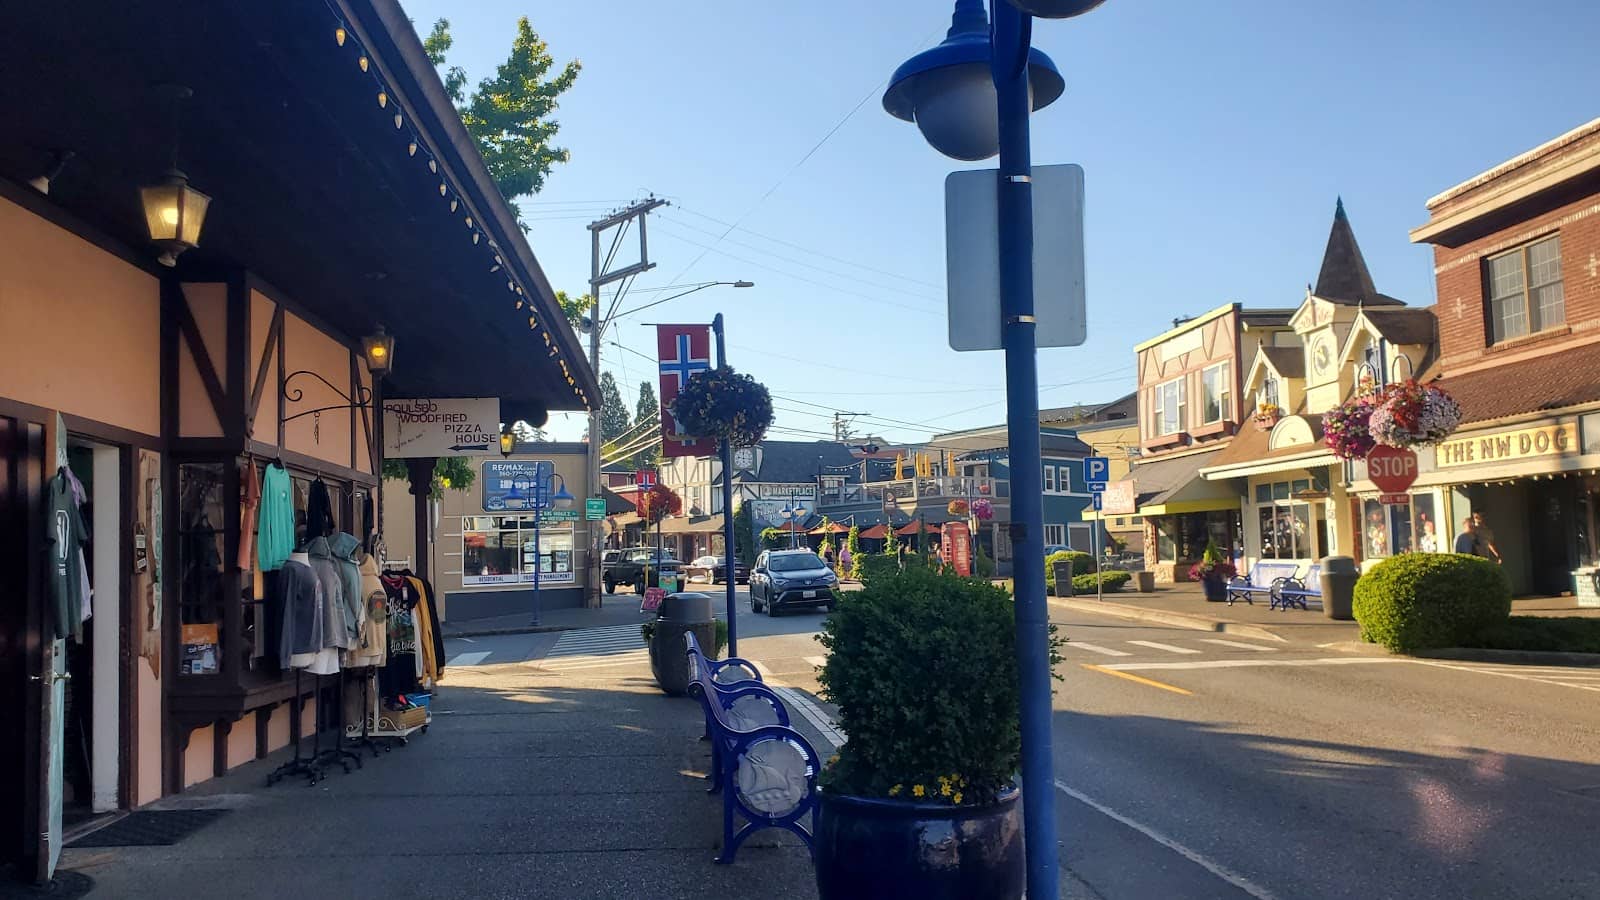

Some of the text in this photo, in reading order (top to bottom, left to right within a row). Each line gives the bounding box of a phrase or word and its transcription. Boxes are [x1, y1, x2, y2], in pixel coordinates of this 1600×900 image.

[385, 403, 437, 413] POULSBO
[400, 413, 467, 423] WOODFIRED
[444, 424, 482, 433] PIZZA
[455, 433, 497, 444] HOUSE
[1443, 428, 1568, 463] THE NW DOG
[1090, 461, 1105, 479] P
[1370, 456, 1416, 477] STOP
[772, 487, 813, 496] MARKETPLACE
